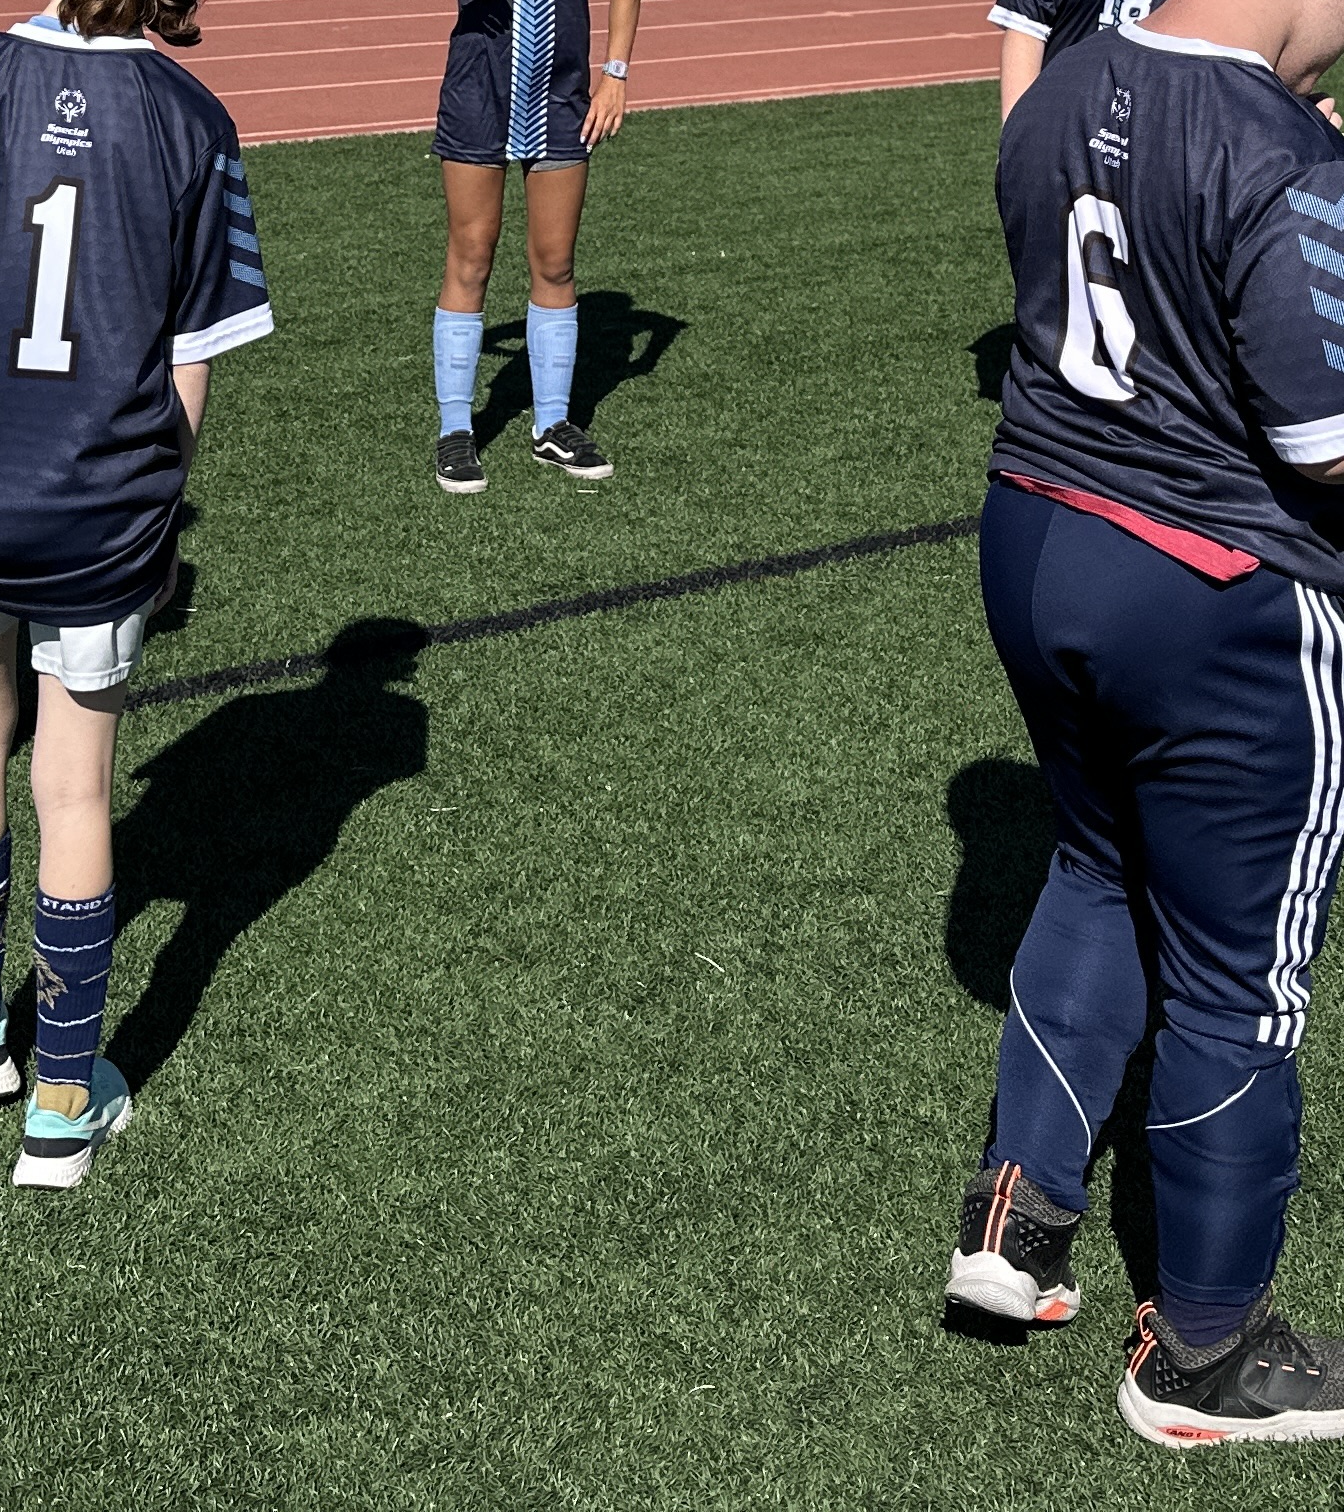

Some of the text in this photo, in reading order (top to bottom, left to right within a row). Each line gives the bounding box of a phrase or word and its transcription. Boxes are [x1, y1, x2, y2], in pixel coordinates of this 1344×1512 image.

[46, 123, 89, 137] Special
[40, 133, 93, 148] Olympics
[56, 145, 77, 157] Utah
[14, 181, 80, 376] 1
[1056, 191, 1141, 404] 6
[42, 896, 102, 912] STAND
